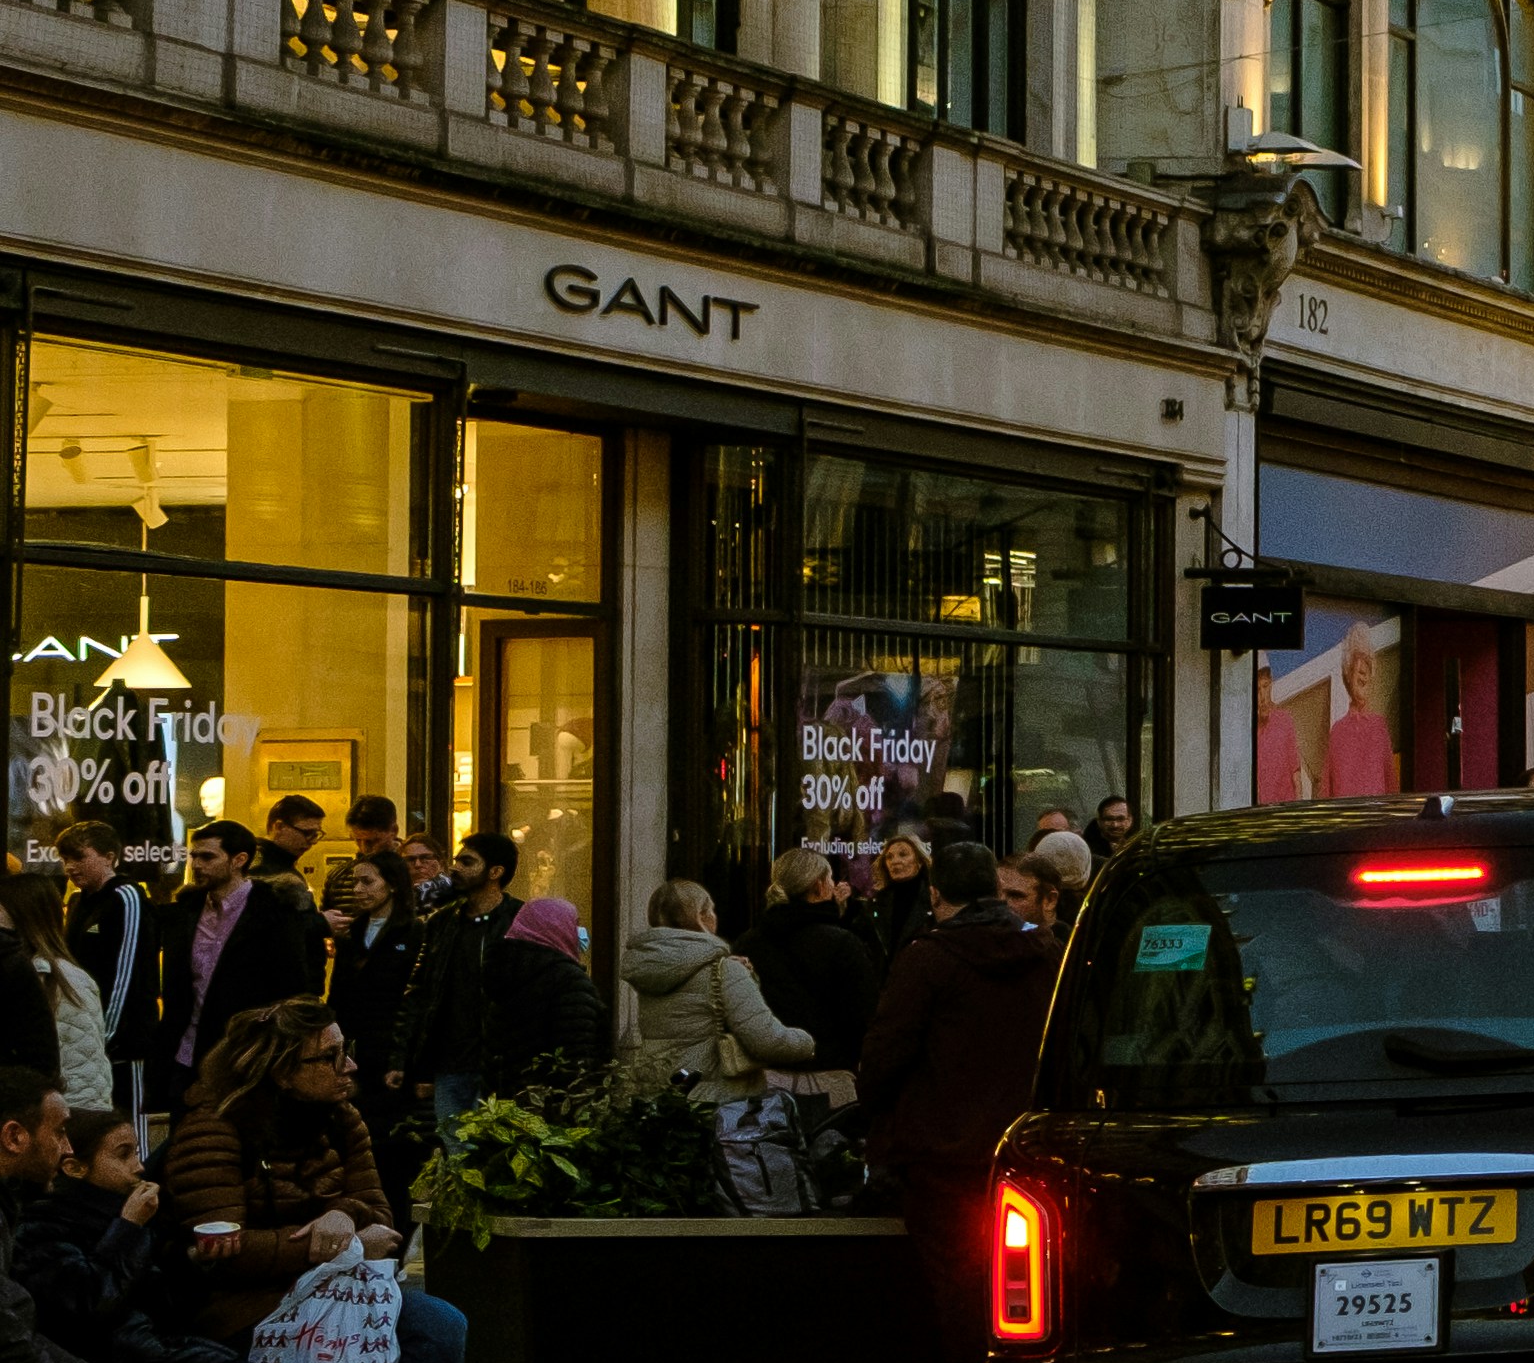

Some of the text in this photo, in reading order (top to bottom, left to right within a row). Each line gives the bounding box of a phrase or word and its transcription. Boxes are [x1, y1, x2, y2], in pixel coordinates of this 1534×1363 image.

[544, 264, 760, 340] GANT
[1298, 293, 1328, 335] 182
[1210, 611, 1293, 624] GANT
[31, 692, 262, 759] Black Friday
[802, 725, 937, 773] Black Friday
[27, 756, 172, 805] 30% off
[802, 774, 885, 810] 30% off
[1273, 1196, 1496, 1245] LR69 WTZ
[1336, 1292, 1412, 1316] 29525
